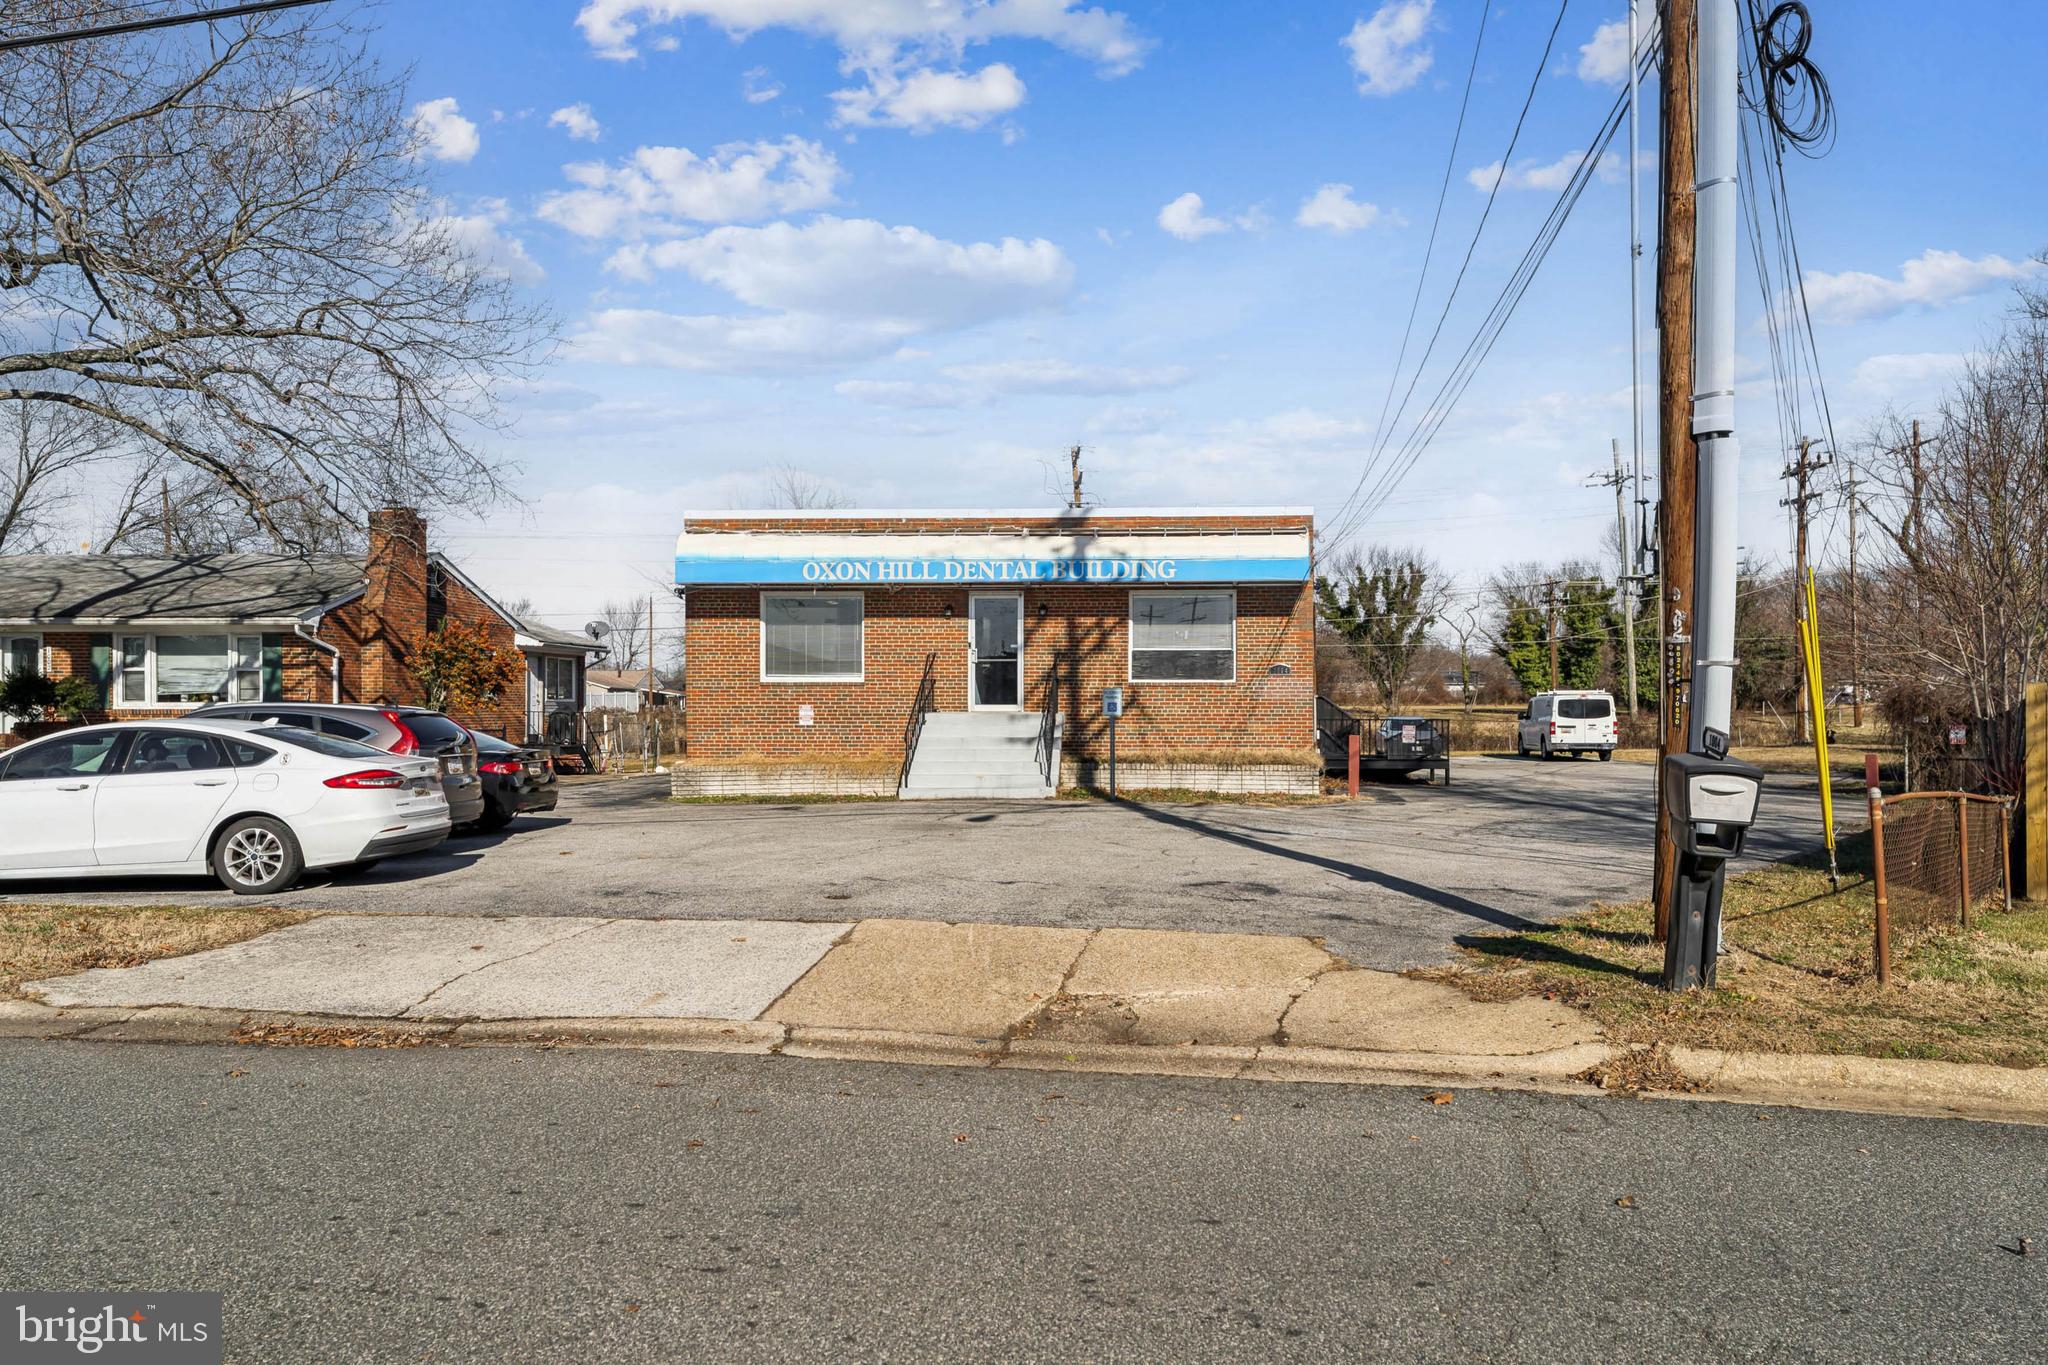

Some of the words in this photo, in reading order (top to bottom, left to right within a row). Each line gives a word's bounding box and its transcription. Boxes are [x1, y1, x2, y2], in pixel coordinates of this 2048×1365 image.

[802, 561, 872, 581] OXON
[877, 561, 938, 580] HILL
[944, 560, 1046, 580] DENTAL
[1052, 560, 1177, 579] BUILDING
